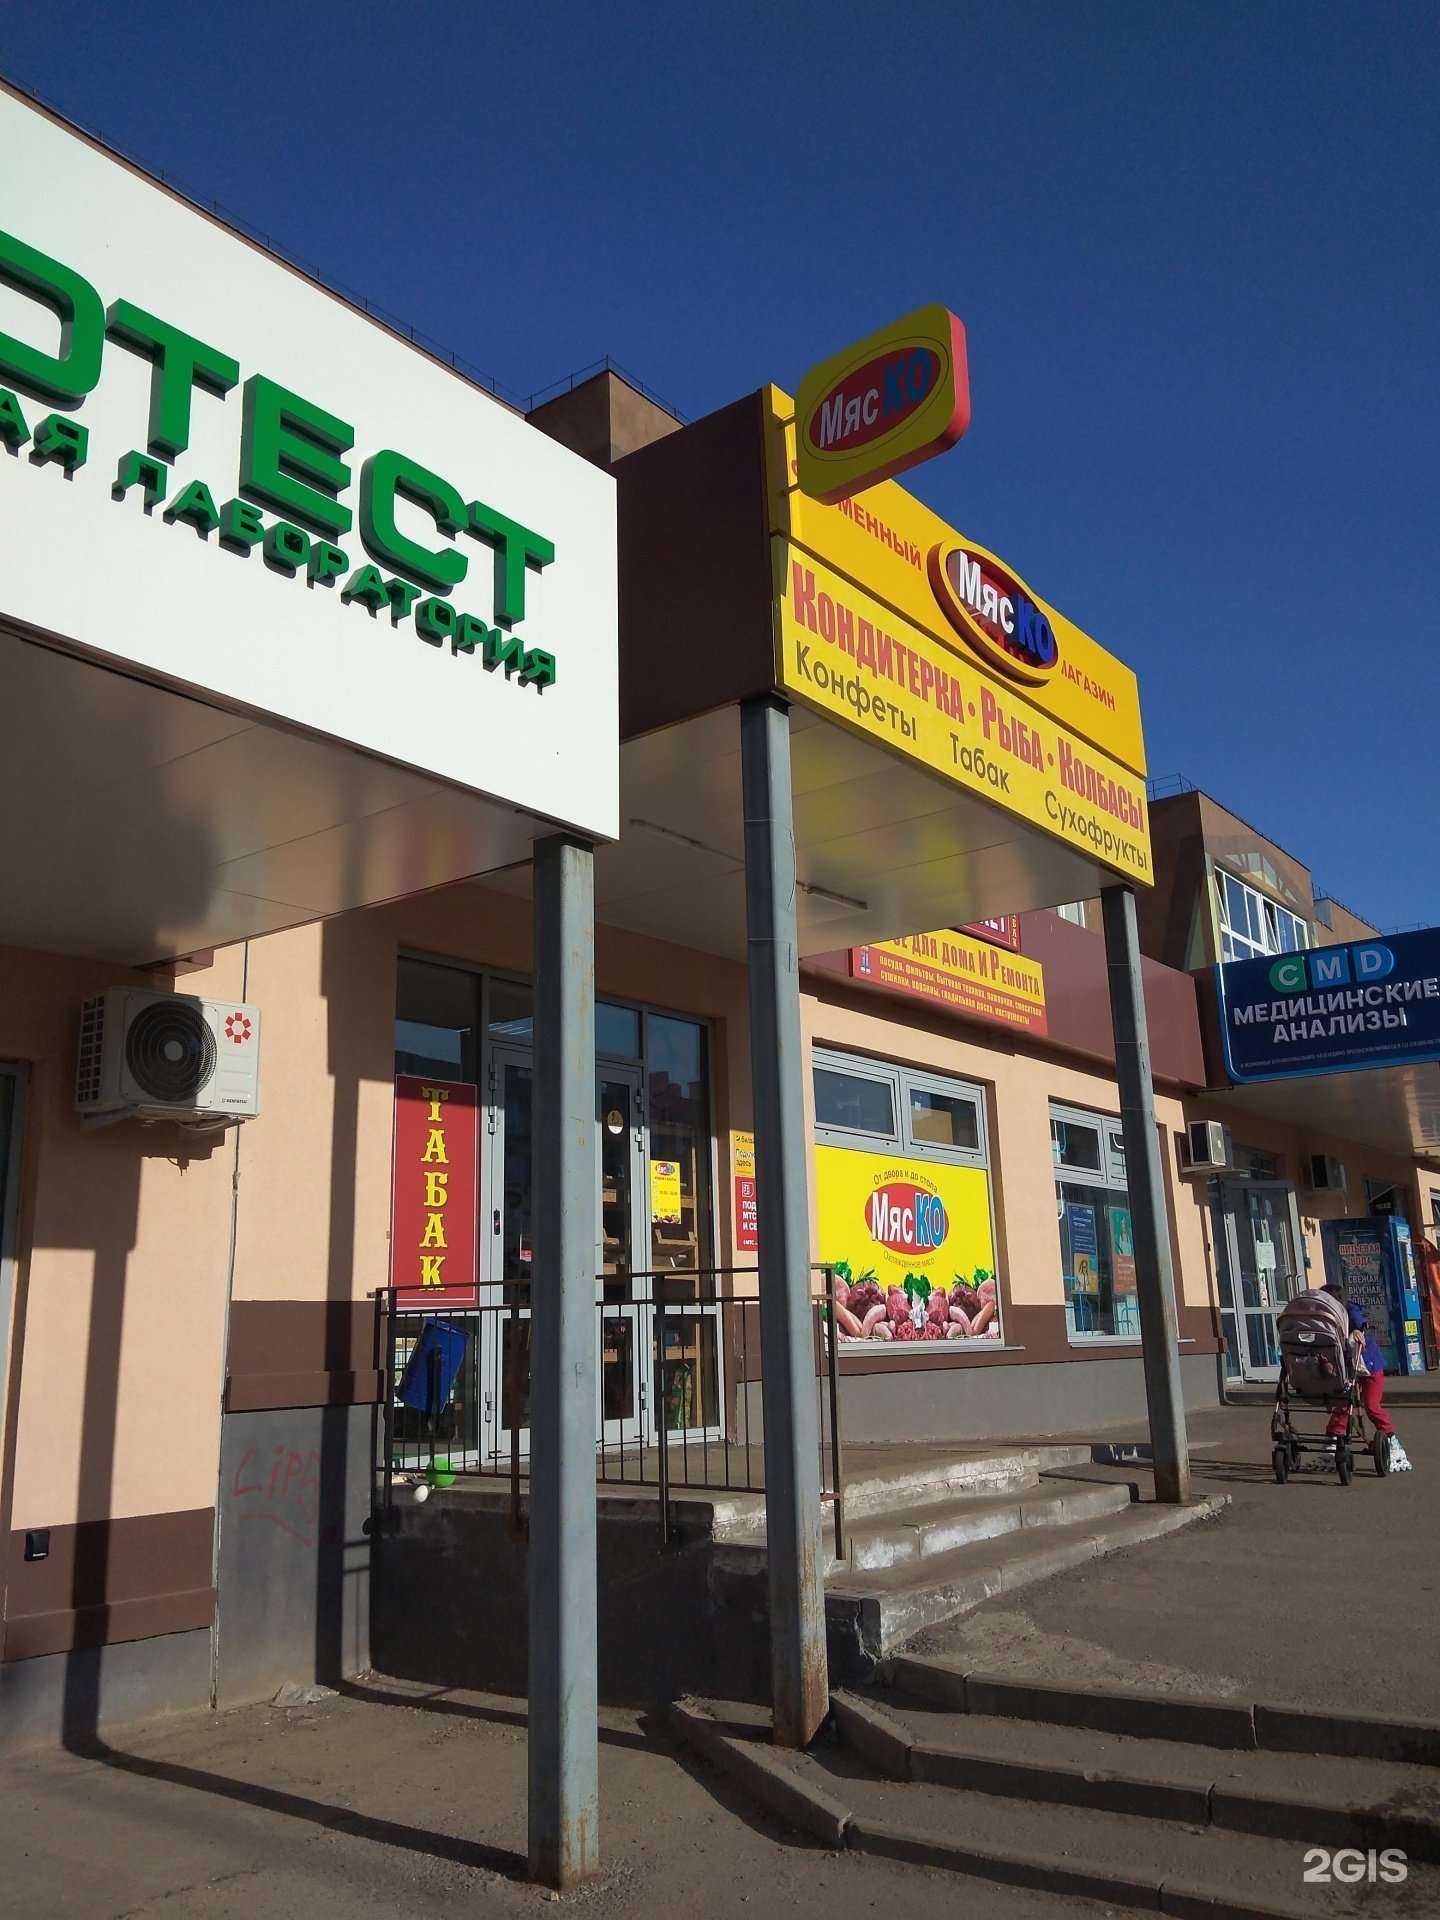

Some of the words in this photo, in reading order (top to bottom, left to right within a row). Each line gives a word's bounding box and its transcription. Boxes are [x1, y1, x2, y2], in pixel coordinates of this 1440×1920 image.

[837, 498, 922, 572] МЕННЫЙ
[111, 449, 556, 695] ЛАБОРАТОРИЯ
[796, 640, 917, 741] Конфеты
[950, 732, 1010, 794] Табак
[1045, 790, 1148, 870] Сухофрукты
[942, 941, 975, 973] ДОМА
[978, 946, 987, 977] И
[1278, 950, 1383, 986] CMD
[1234, 978, 1440, 1026] МЕДИЦИНСКИЕ
[1273, 1007, 1408, 1043] АНАЛИЗЫ
[419, 1086, 450, 1290] ТАБАК
[742, 1201, 757, 1211] ПОД
[749, 1222, 758, 1231] СЕ
